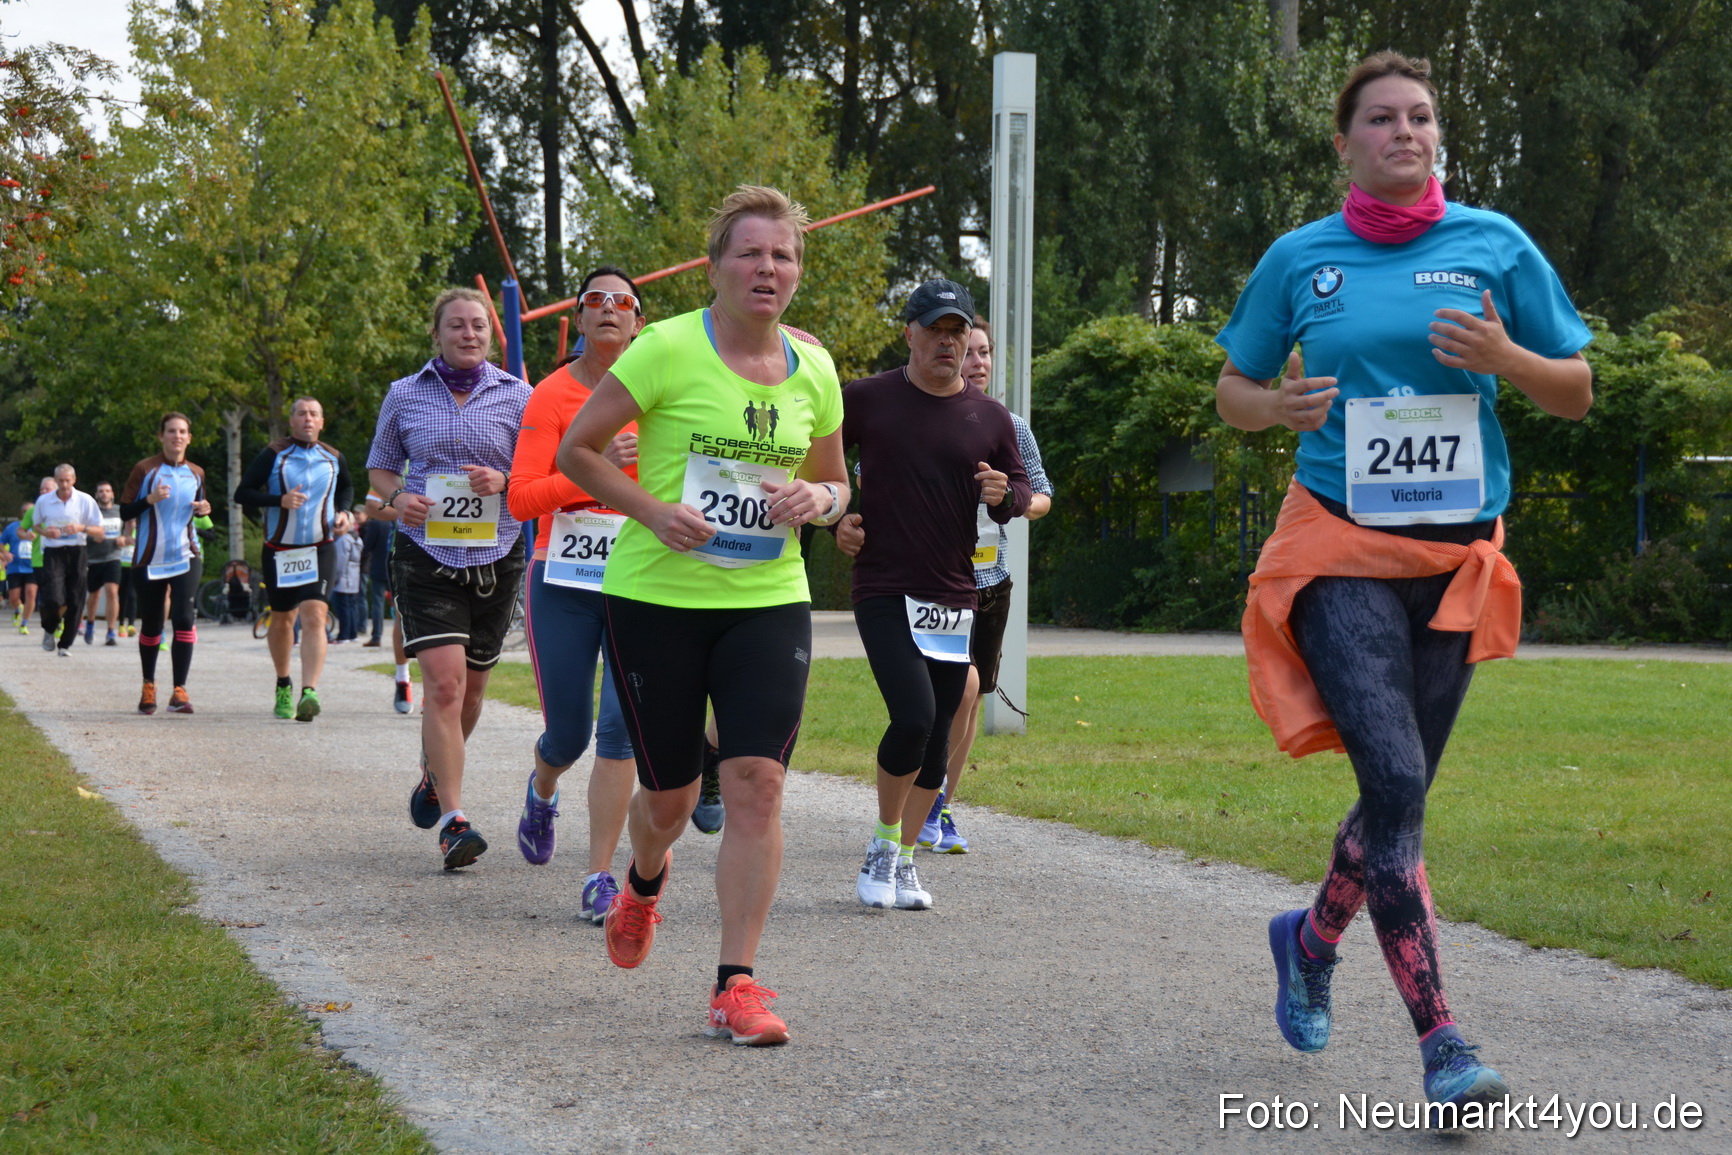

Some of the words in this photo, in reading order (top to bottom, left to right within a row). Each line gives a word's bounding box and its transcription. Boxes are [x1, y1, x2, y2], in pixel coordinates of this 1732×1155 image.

[1313, 267, 1341, 280] BMW
[1414, 271, 1477, 289] BOCK
[1314, 298, 1344, 314] PARTL
[1399, 408, 1442, 419] BOCK
[690, 432, 713, 444] SC
[1367, 435, 1461, 475] 2447
[731, 471, 762, 483] BOCK
[1391, 488, 1443, 502] Victoria
[443, 496, 483, 518] 223
[699, 490, 775, 530] 2308
[584, 517, 615, 526] BOCK
[453, 526, 473, 534] Karin
[712, 536, 752, 552] Andrea
[283, 559, 312, 574] 2702
[913, 606, 963, 630] 2917
